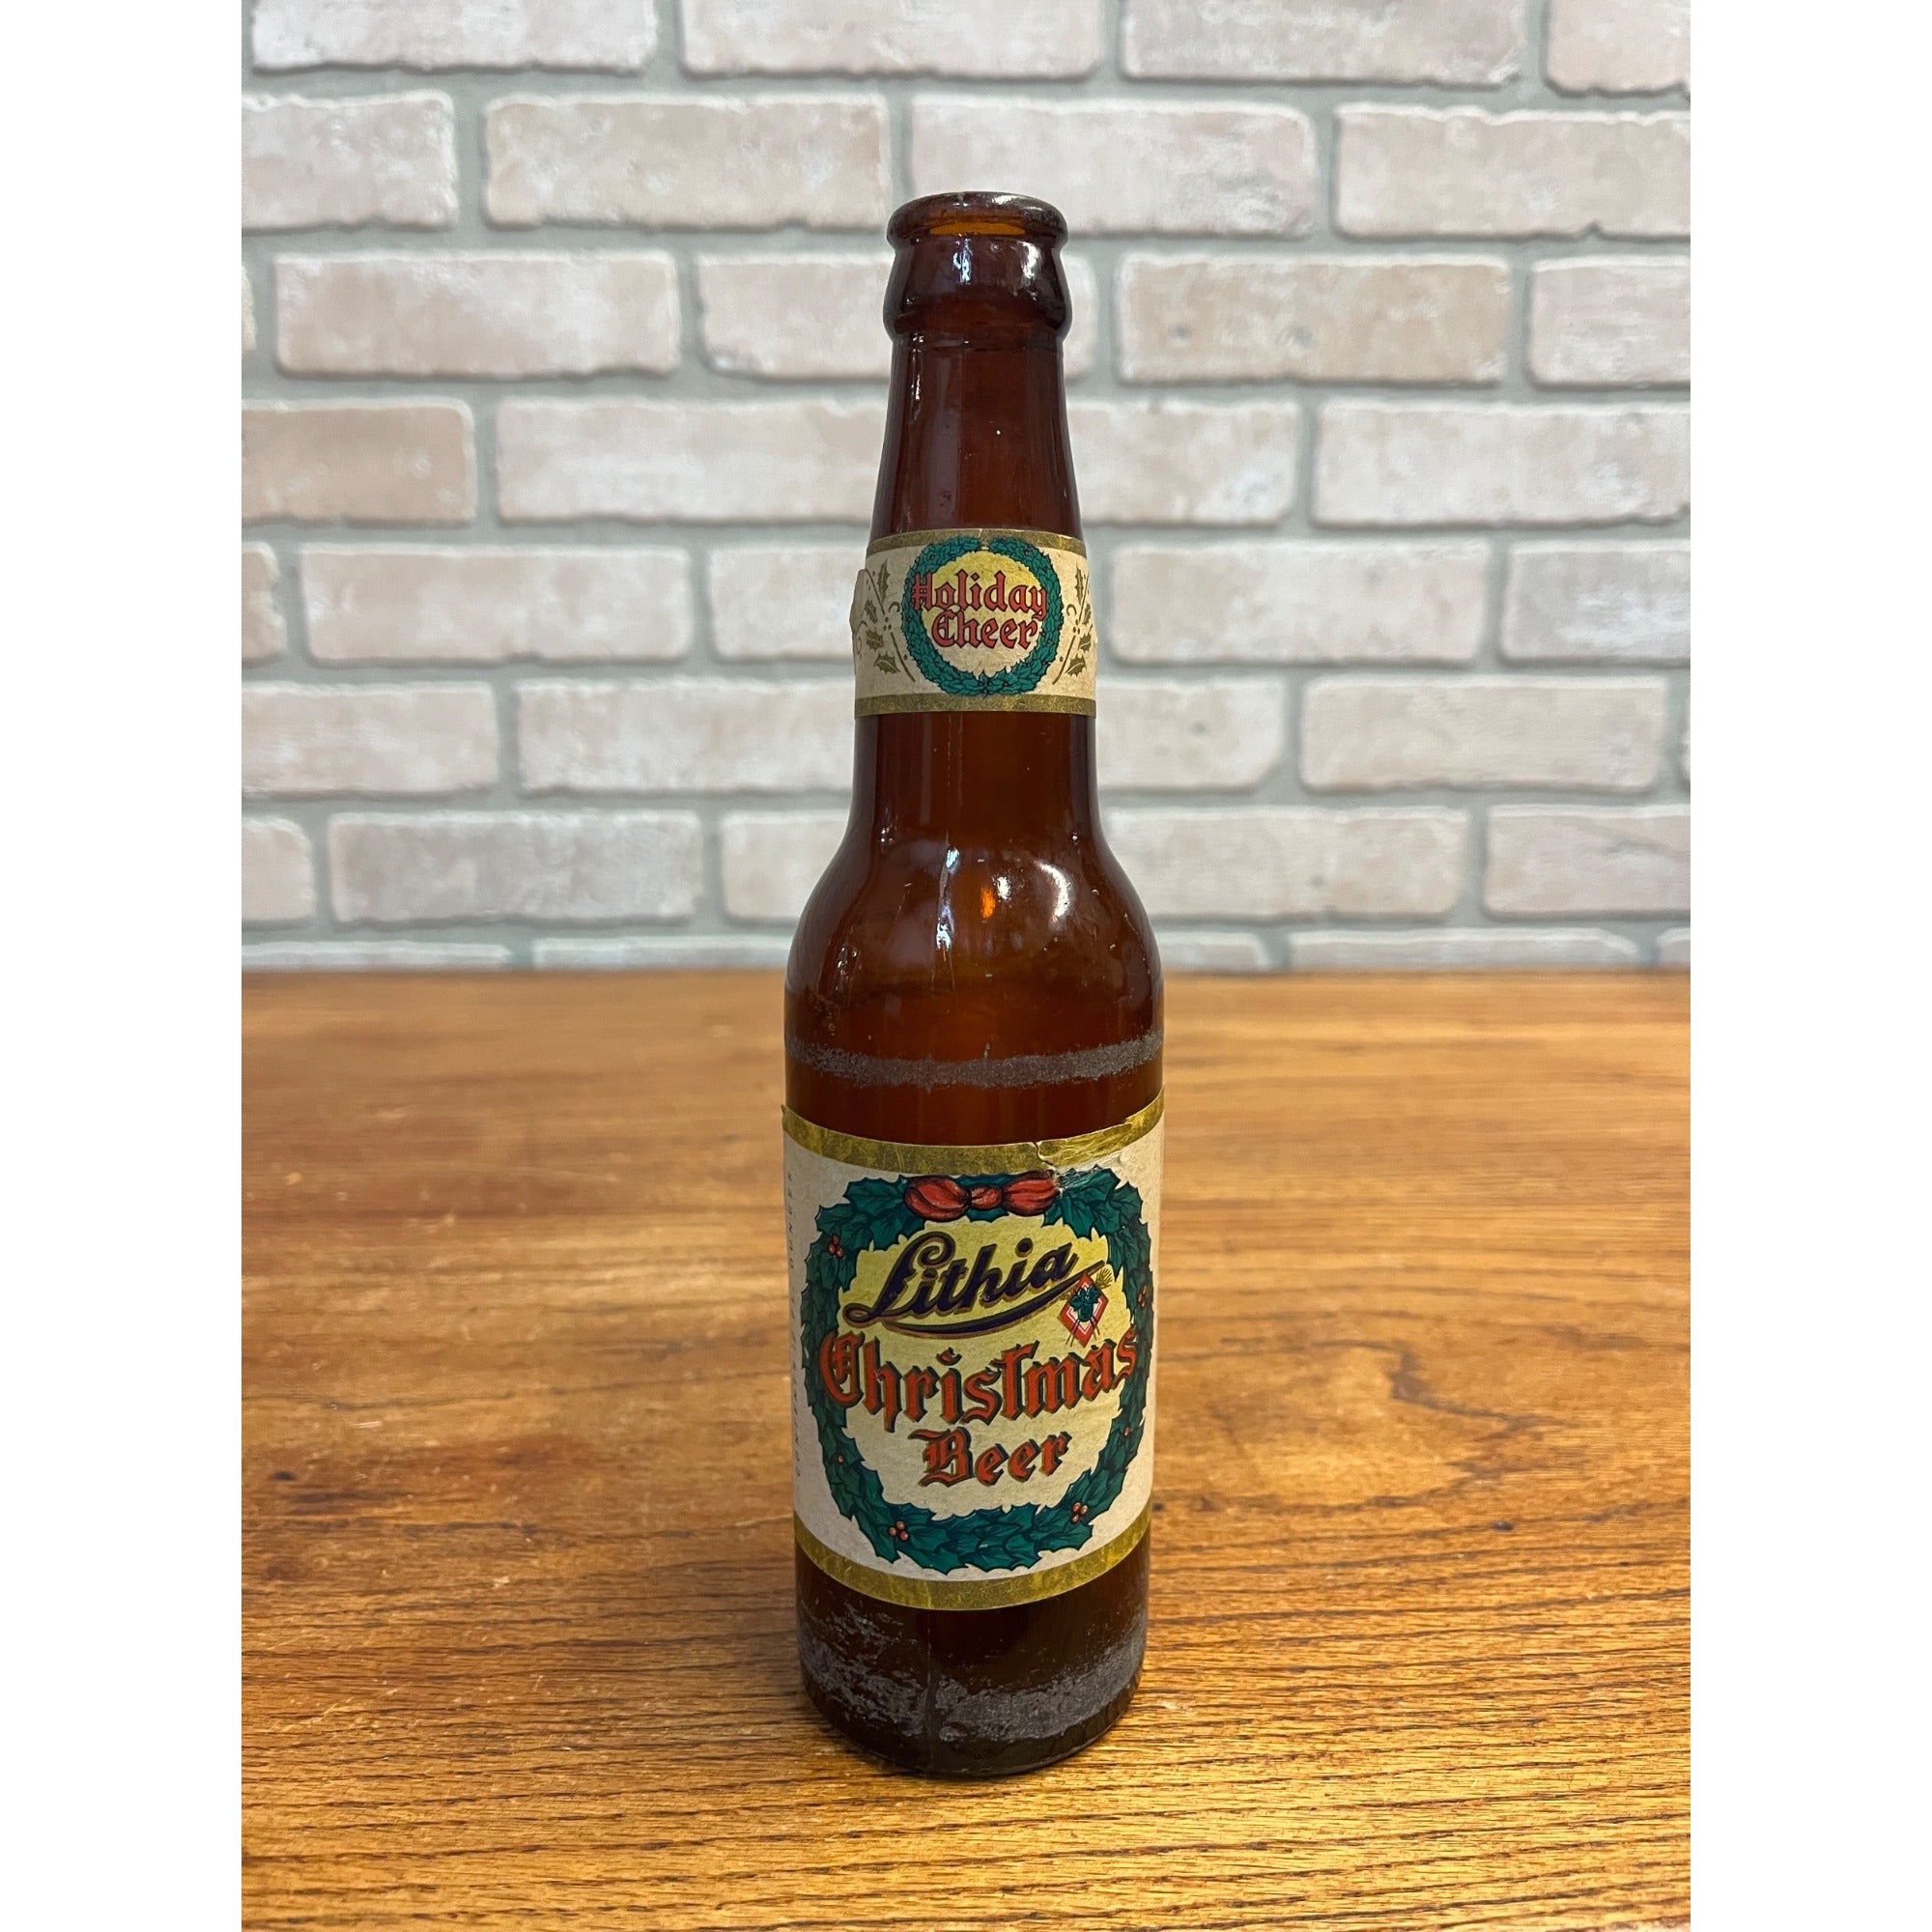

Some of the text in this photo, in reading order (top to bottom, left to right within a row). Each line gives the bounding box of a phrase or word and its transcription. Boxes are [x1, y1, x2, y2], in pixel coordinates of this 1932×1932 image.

[911, 568, 1048, 620] Holiday
[930, 605, 1039, 650] Cheer
[841, 1231, 1084, 1330] Lithia
[818, 1321, 1140, 1434] Christmas
[906, 1426, 1073, 1489] Beer
